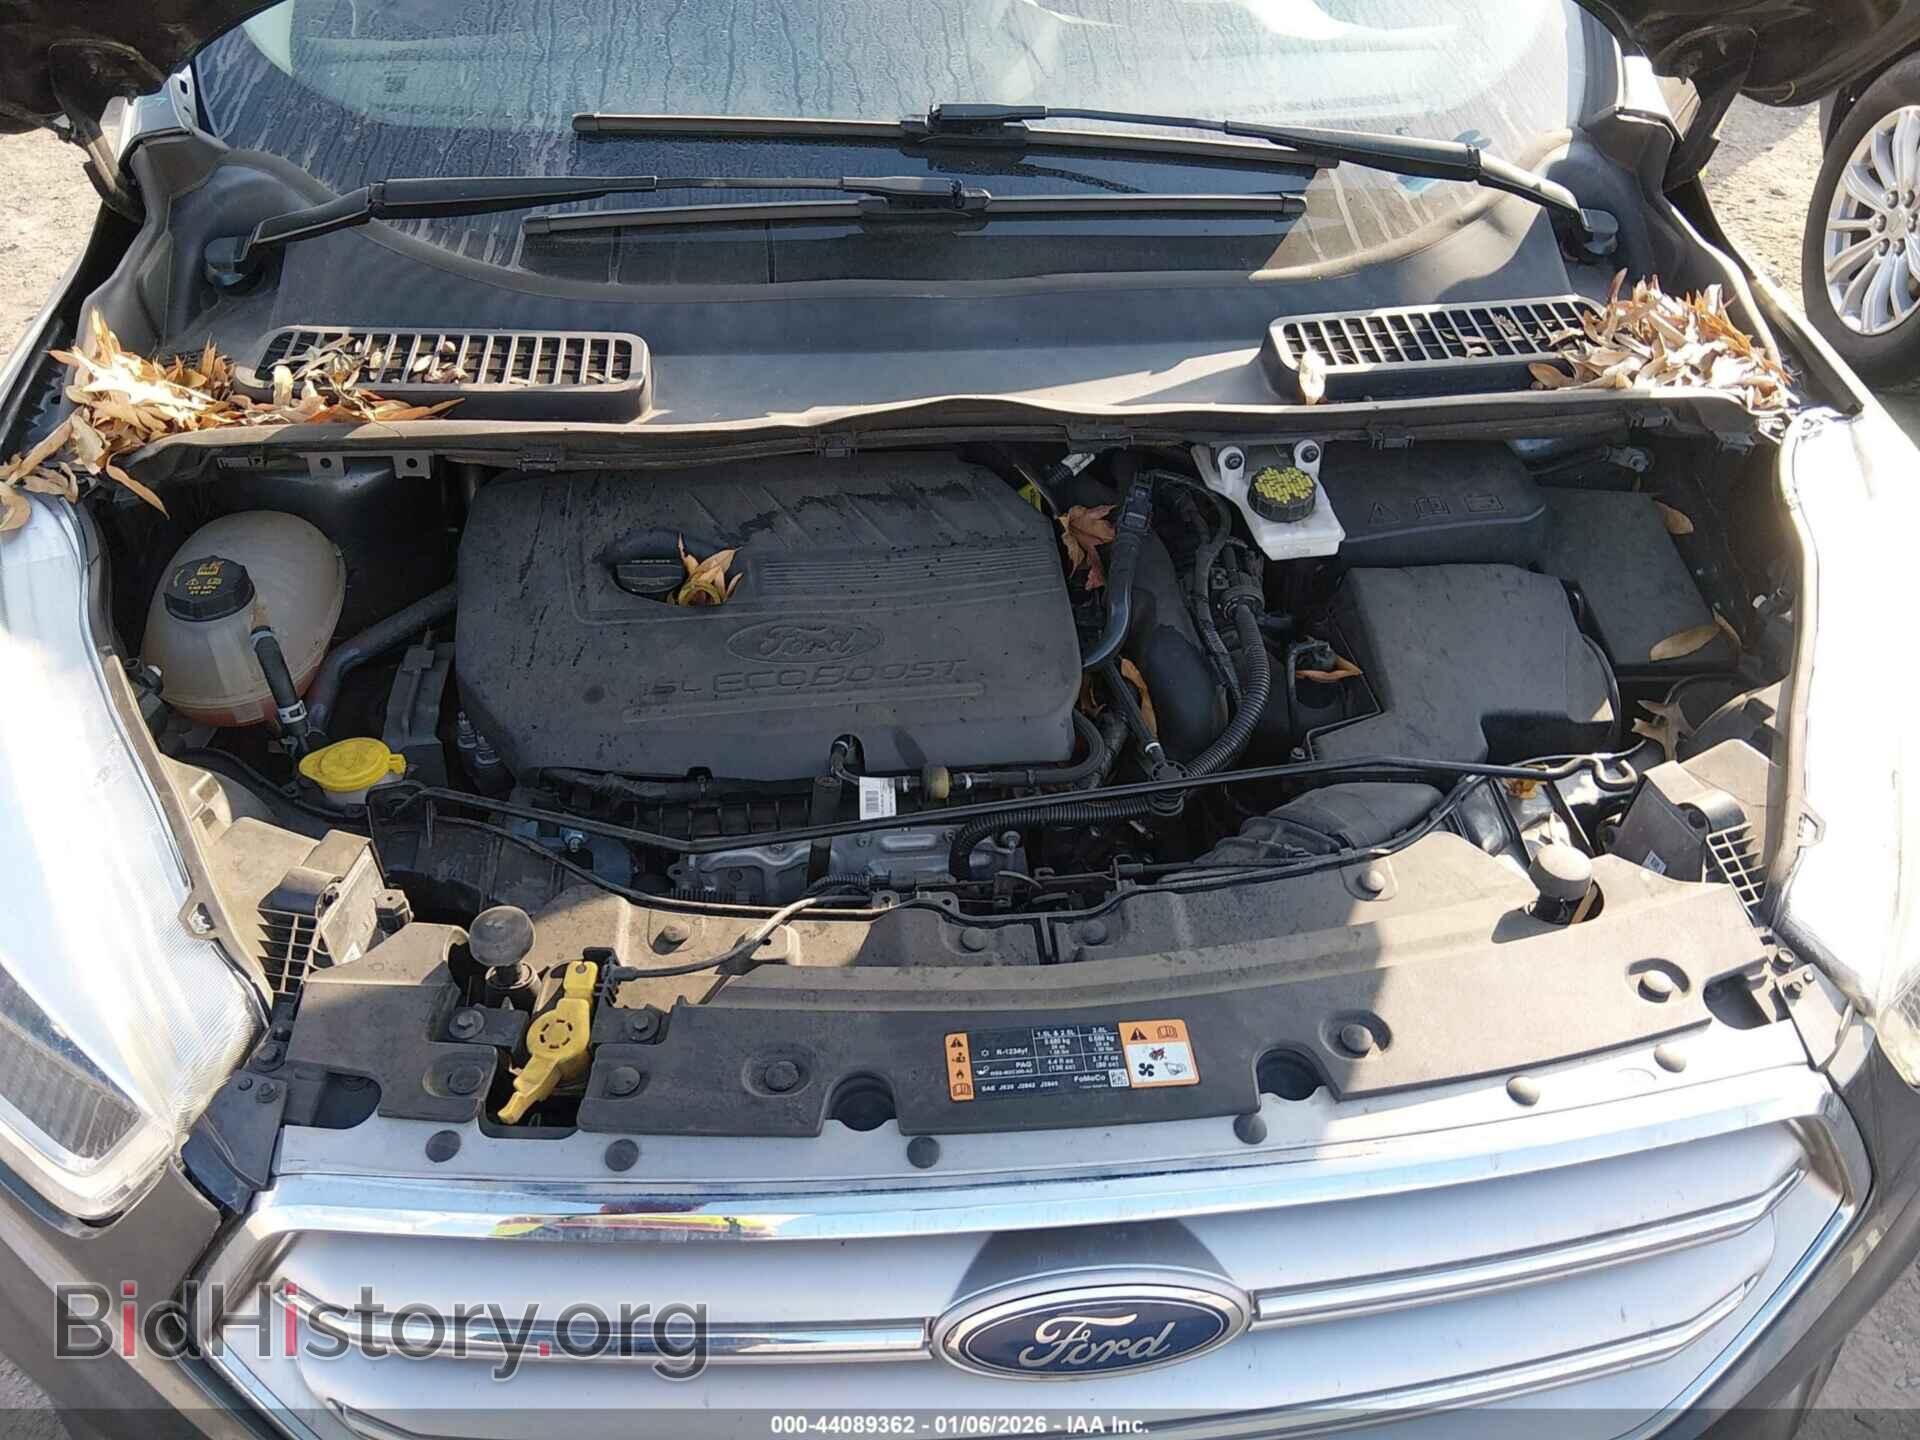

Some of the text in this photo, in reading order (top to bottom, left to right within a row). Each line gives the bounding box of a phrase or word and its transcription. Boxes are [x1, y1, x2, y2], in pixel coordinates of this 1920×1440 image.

[760, 624, 864, 658] Ford
[713, 659, 968, 694] ECOBOOST
[1018, 1312, 1177, 1368] Ford
